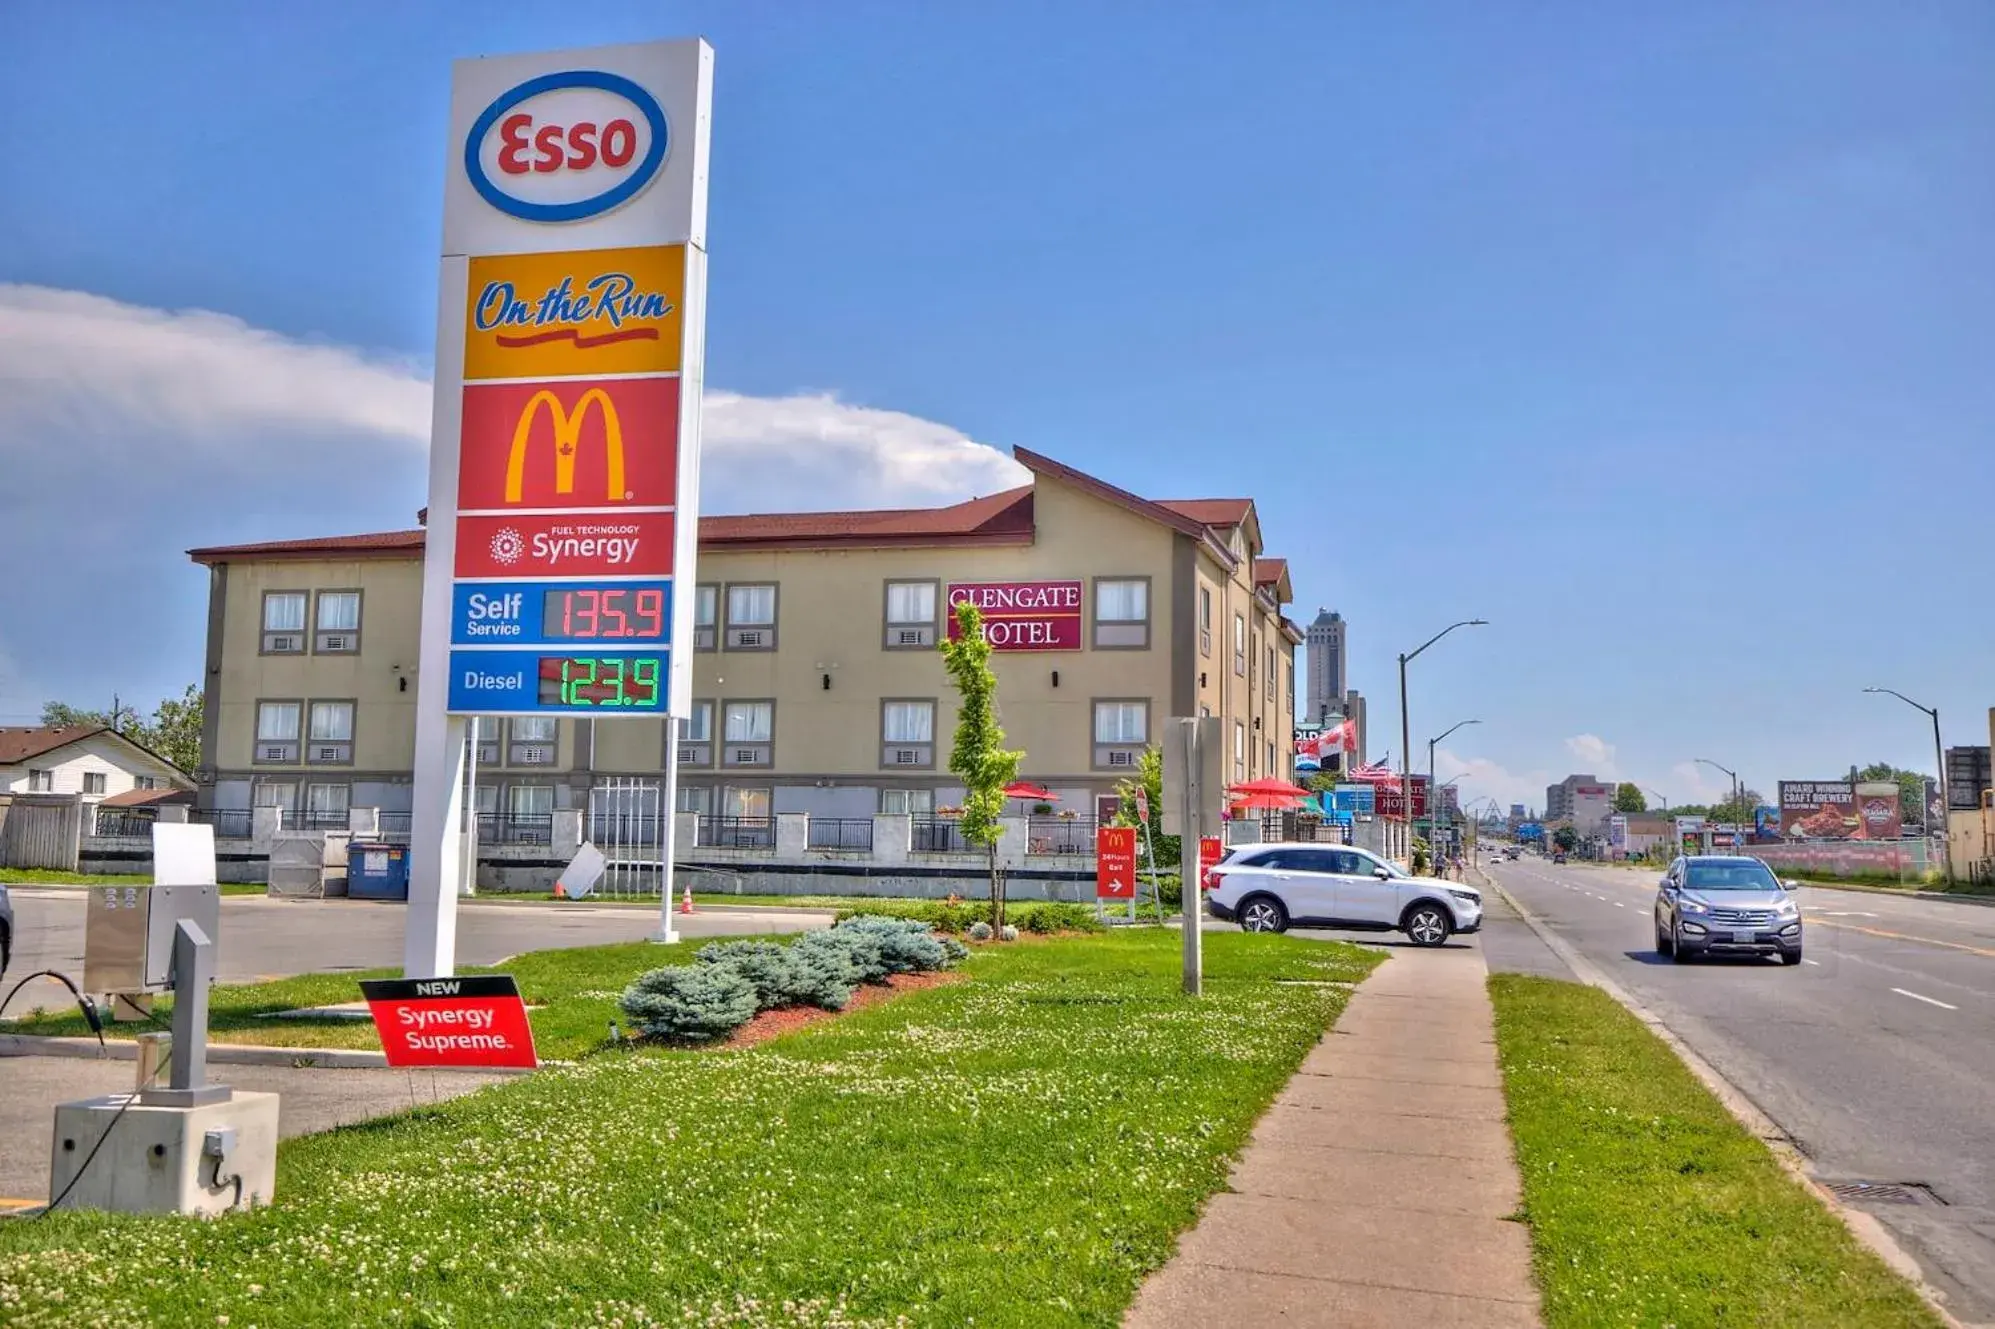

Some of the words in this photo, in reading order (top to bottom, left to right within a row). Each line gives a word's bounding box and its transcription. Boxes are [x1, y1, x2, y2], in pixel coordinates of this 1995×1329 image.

[475, 280, 537, 330] On
[534, 275, 593, 326] the
[587, 272, 674, 328] Run
[551, 526, 574, 535] FUEL
[576, 524, 640, 534] TECHNOLOGY
[531, 532, 639, 564] Synergy
[467, 592, 523, 620] Self
[562, 590, 663, 637] 135.9
[467, 620, 521, 636] Service
[464, 671, 523, 690] Diesel
[560, 658, 660, 706] 123.9
[1783, 793, 1811, 802] CRAFT
[1812, 793, 1853, 803] BREWERY
[417, 981, 461, 996] NEW
[397, 1006, 495, 1029] Synergy
